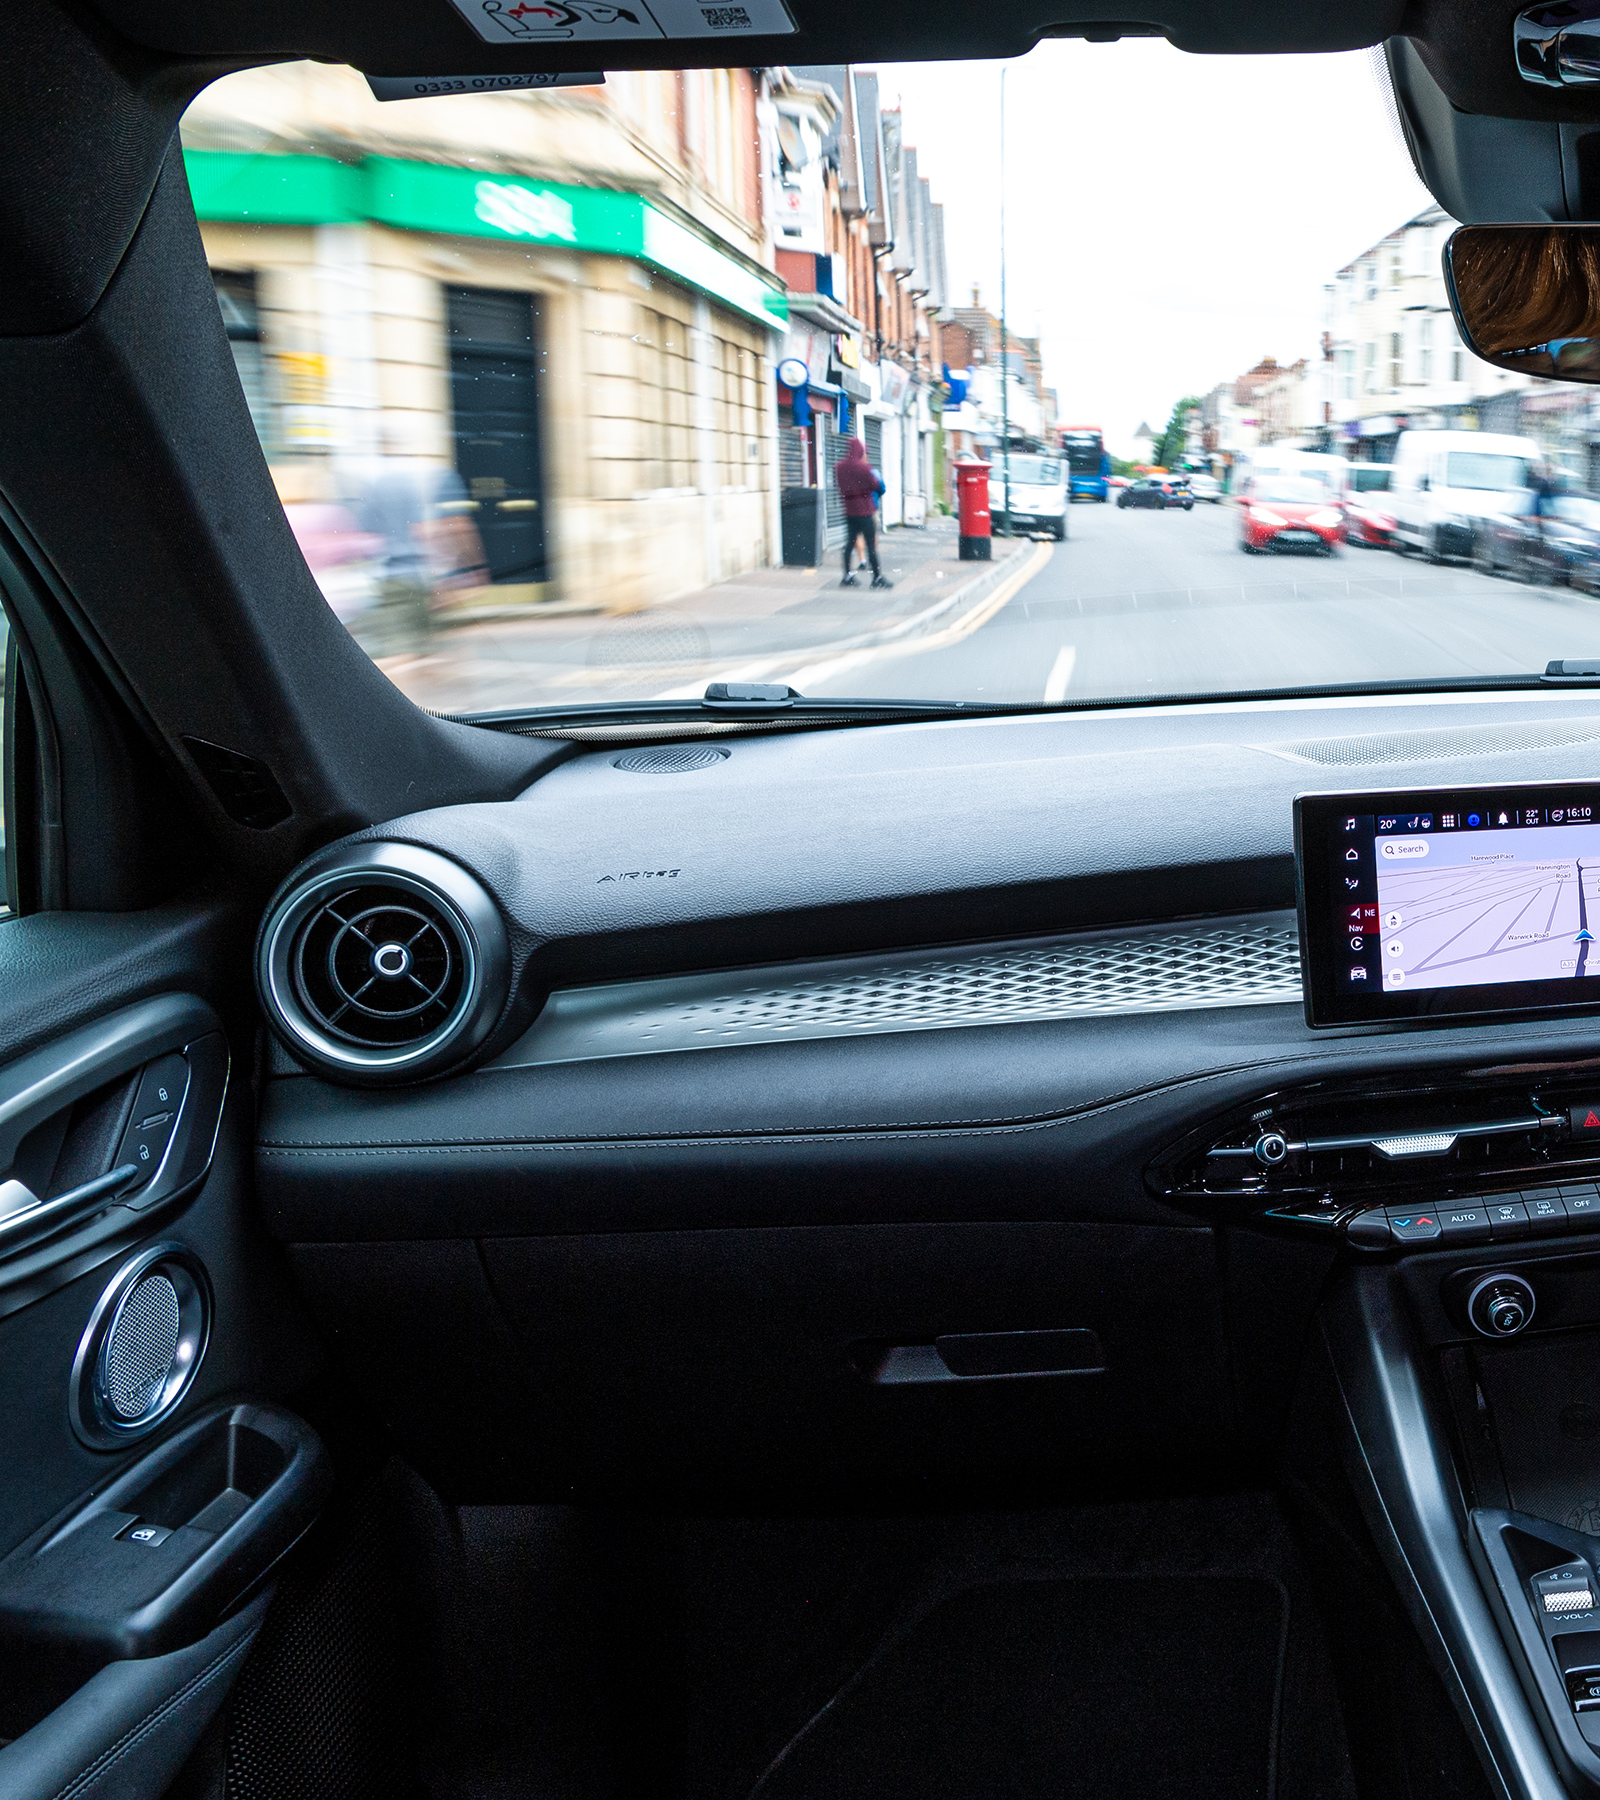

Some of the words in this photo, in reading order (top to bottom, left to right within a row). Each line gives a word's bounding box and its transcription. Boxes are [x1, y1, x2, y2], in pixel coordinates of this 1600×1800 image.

[414, 81, 466, 93] 0333
[472, 73, 559, 89] 0702797
[1567, 807, 1591, 817] 16:10
[1380, 819, 1397, 829] 20°
[1398, 845, 1424, 854] Search
[1364, 909, 1376, 917] NE
[1574, 1200, 1591, 1208] OFF
[1451, 1213, 1476, 1223] AUTO
